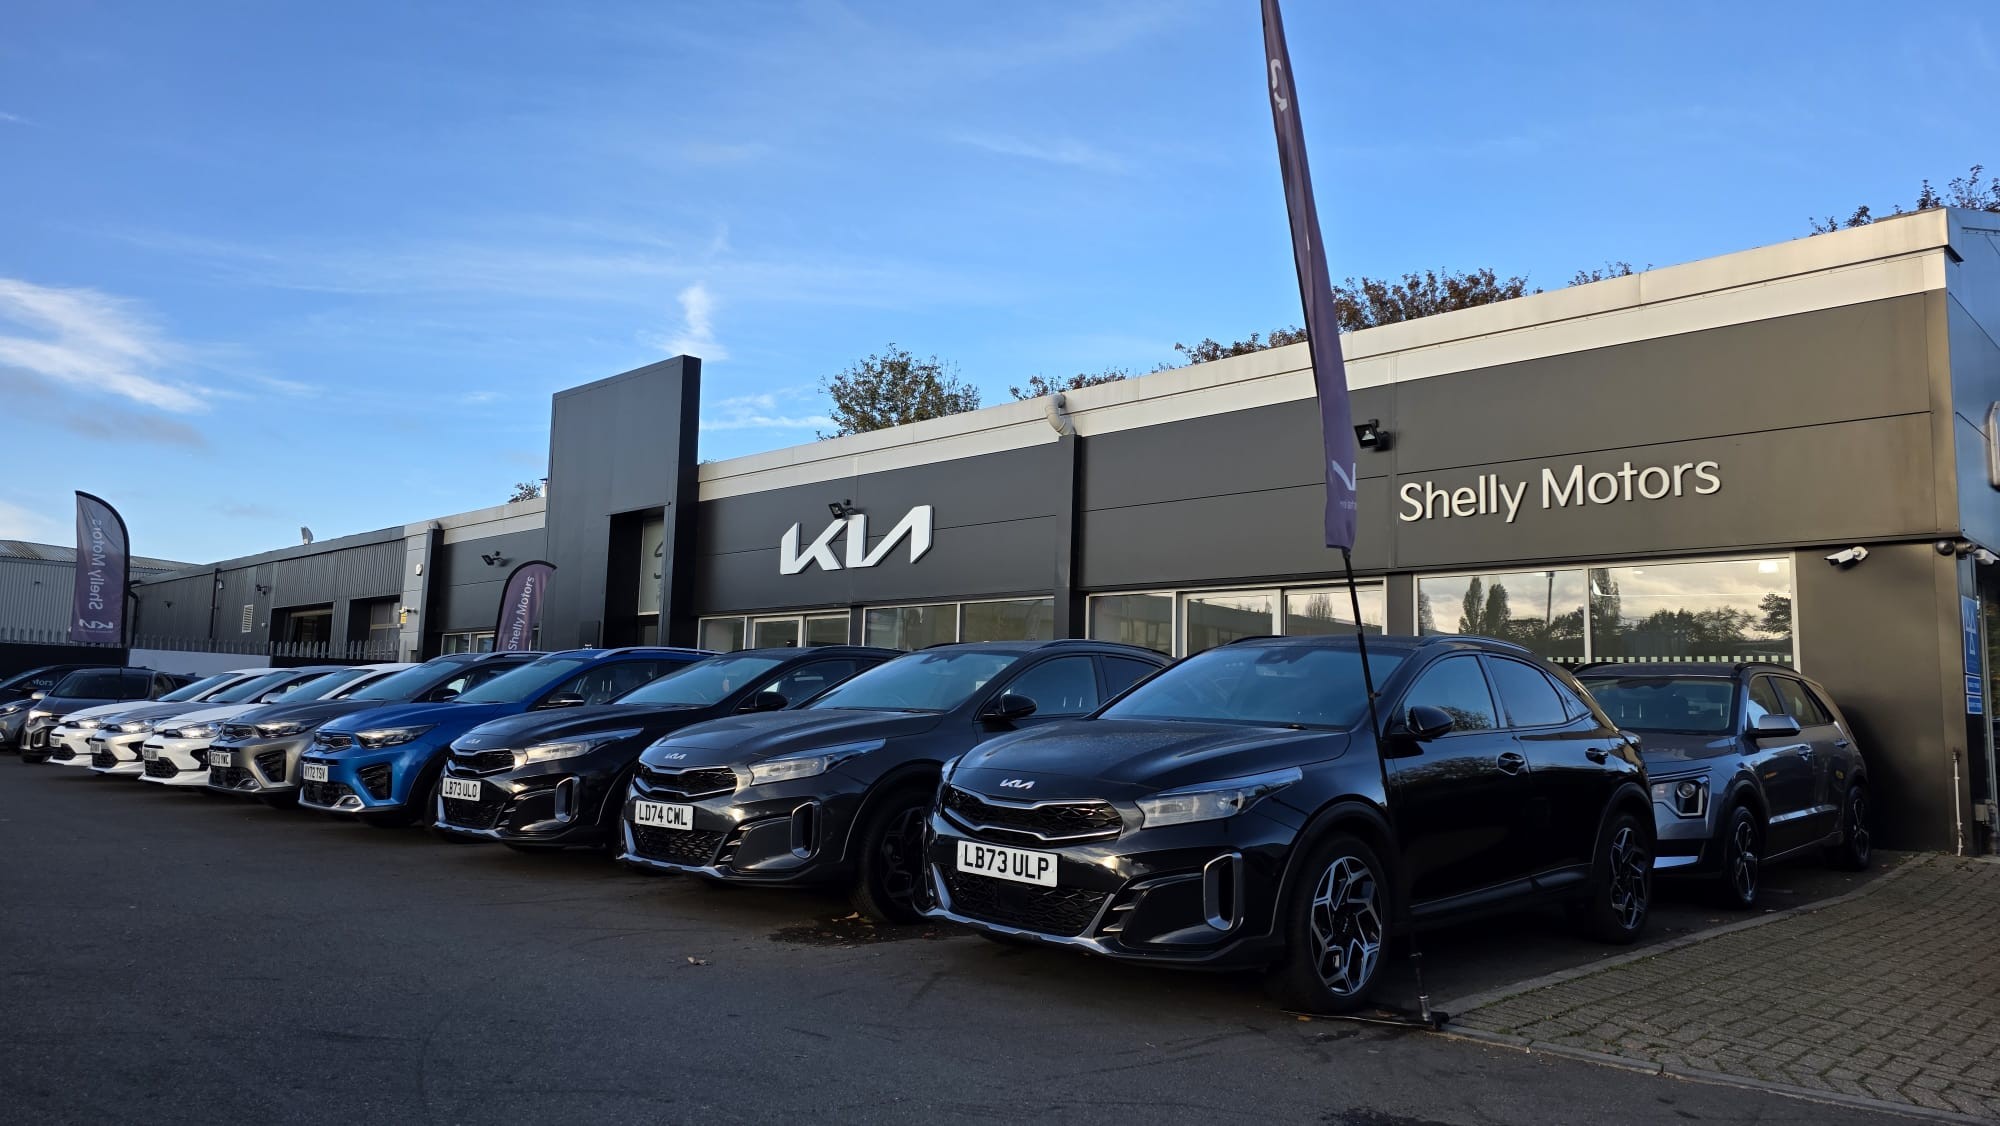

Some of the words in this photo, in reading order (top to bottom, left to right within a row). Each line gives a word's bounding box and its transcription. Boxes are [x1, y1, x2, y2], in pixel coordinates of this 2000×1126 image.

[1399, 474, 1528, 524] Shelly
[1541, 460, 1722, 510] Motors
[780, 504, 933, 575] KIA
[516, 576, 535, 616] Motors
[508, 618, 526, 650] Shelly
[444, 780, 462, 796] LB73
[1000, 778, 1036, 790] KIA
[639, 803, 664, 824] LD74
[666, 806, 688, 826] CWL
[963, 844, 1008, 874] LB73
[1012, 852, 1050, 881] ULP
